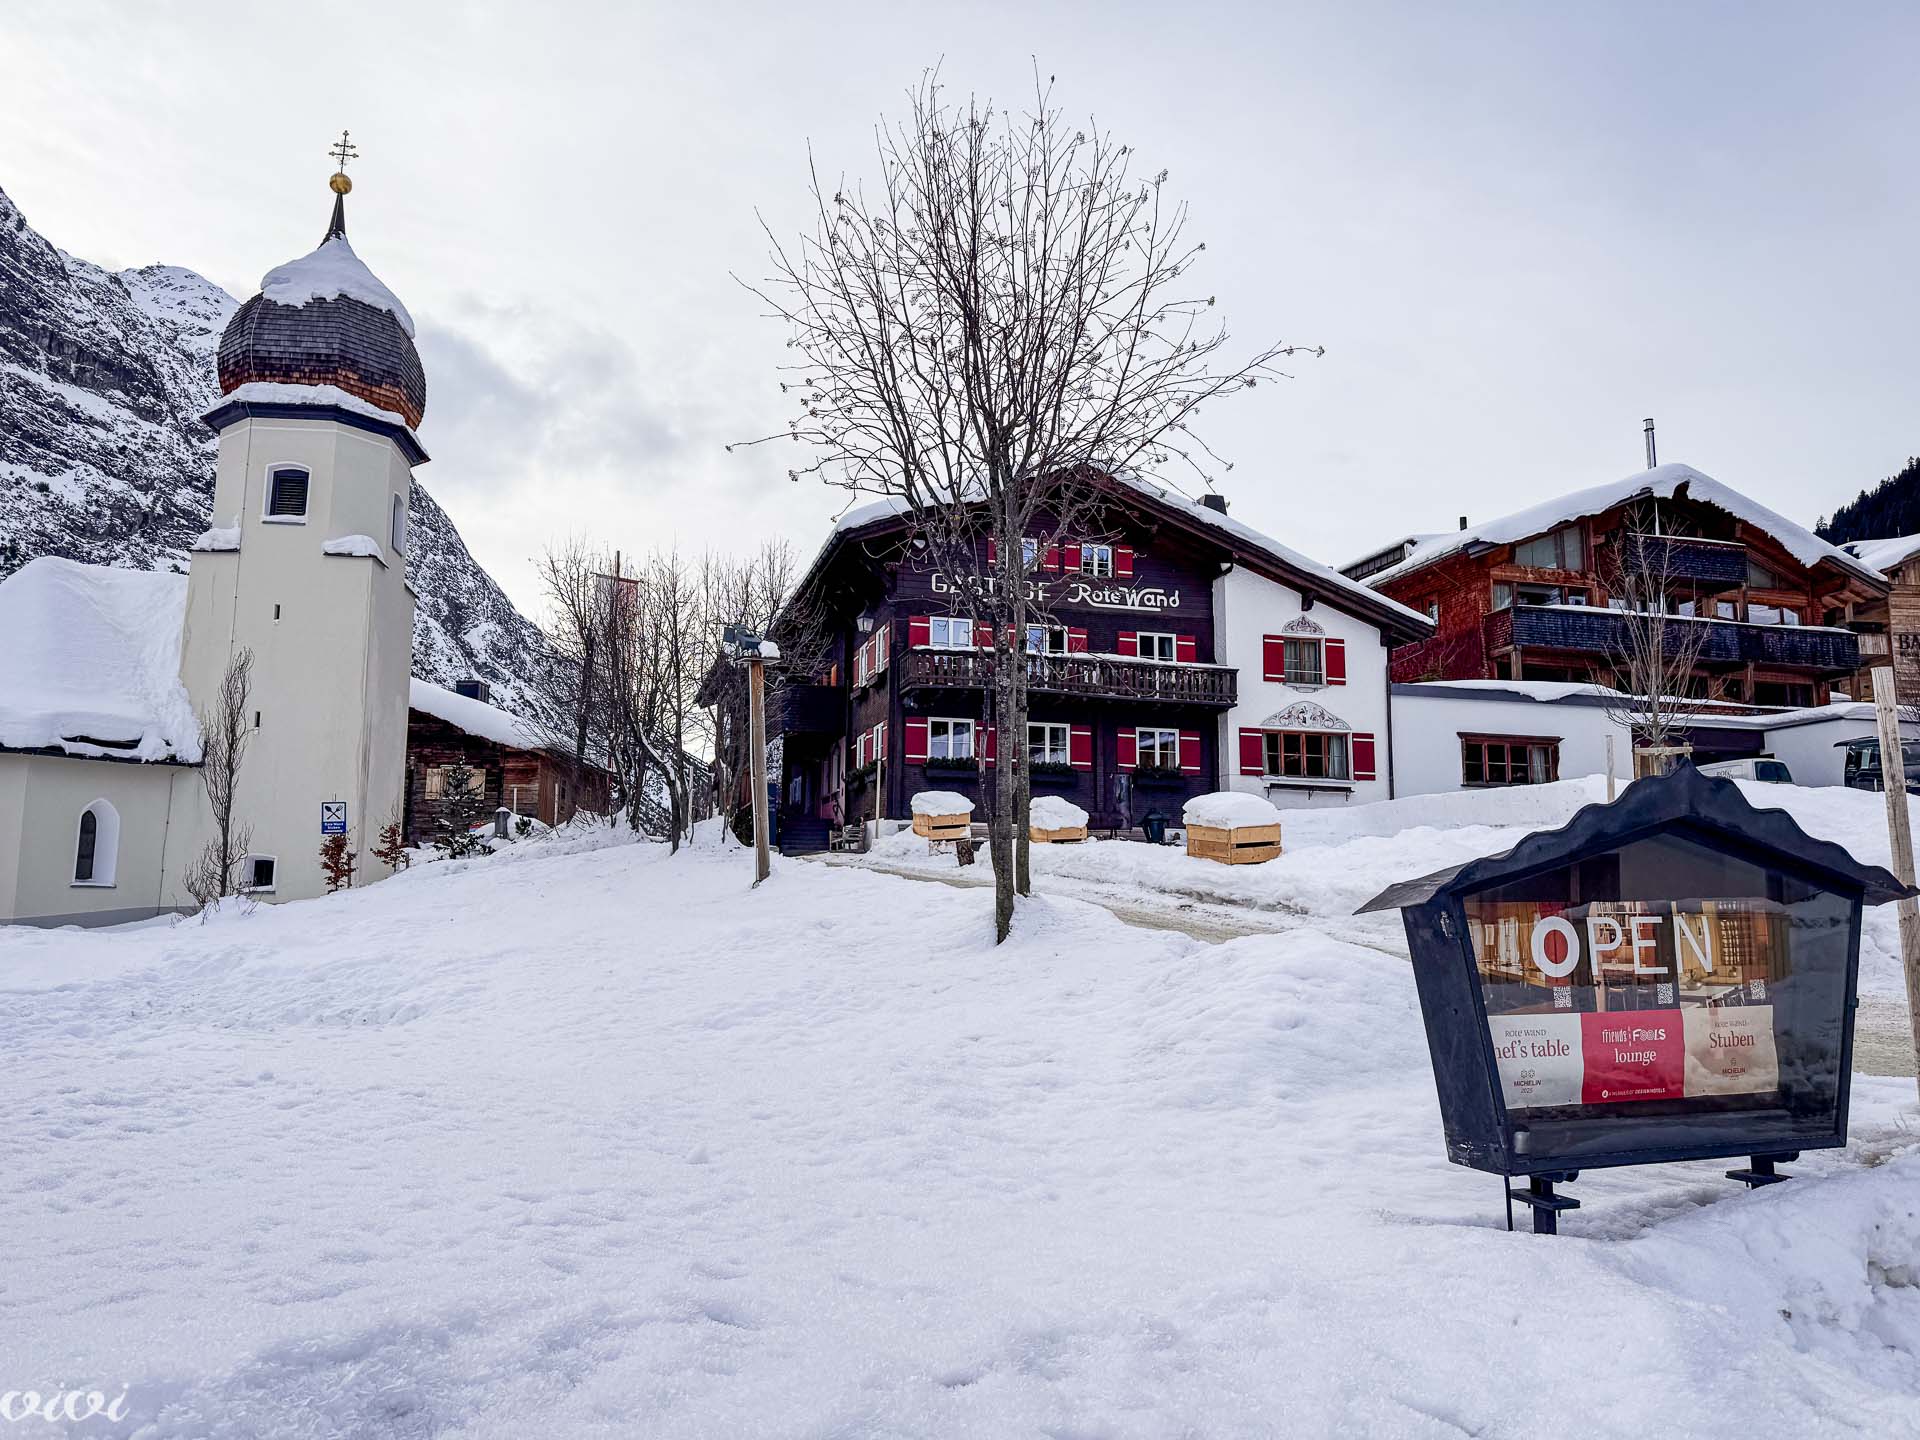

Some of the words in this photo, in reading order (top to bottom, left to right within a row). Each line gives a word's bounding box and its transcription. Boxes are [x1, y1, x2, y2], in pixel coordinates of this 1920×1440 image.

[1067, 583, 1120, 604] Rote
[1118, 586, 1180, 609] Wand
[1531, 916, 1713, 978] OPEN
[1531, 1039, 1570, 1058] table
[1709, 1030, 1754, 1049] Stuben
[1614, 1047, 1657, 1066] lounge
[1513, 1079, 1542, 1087] MICHELIN
